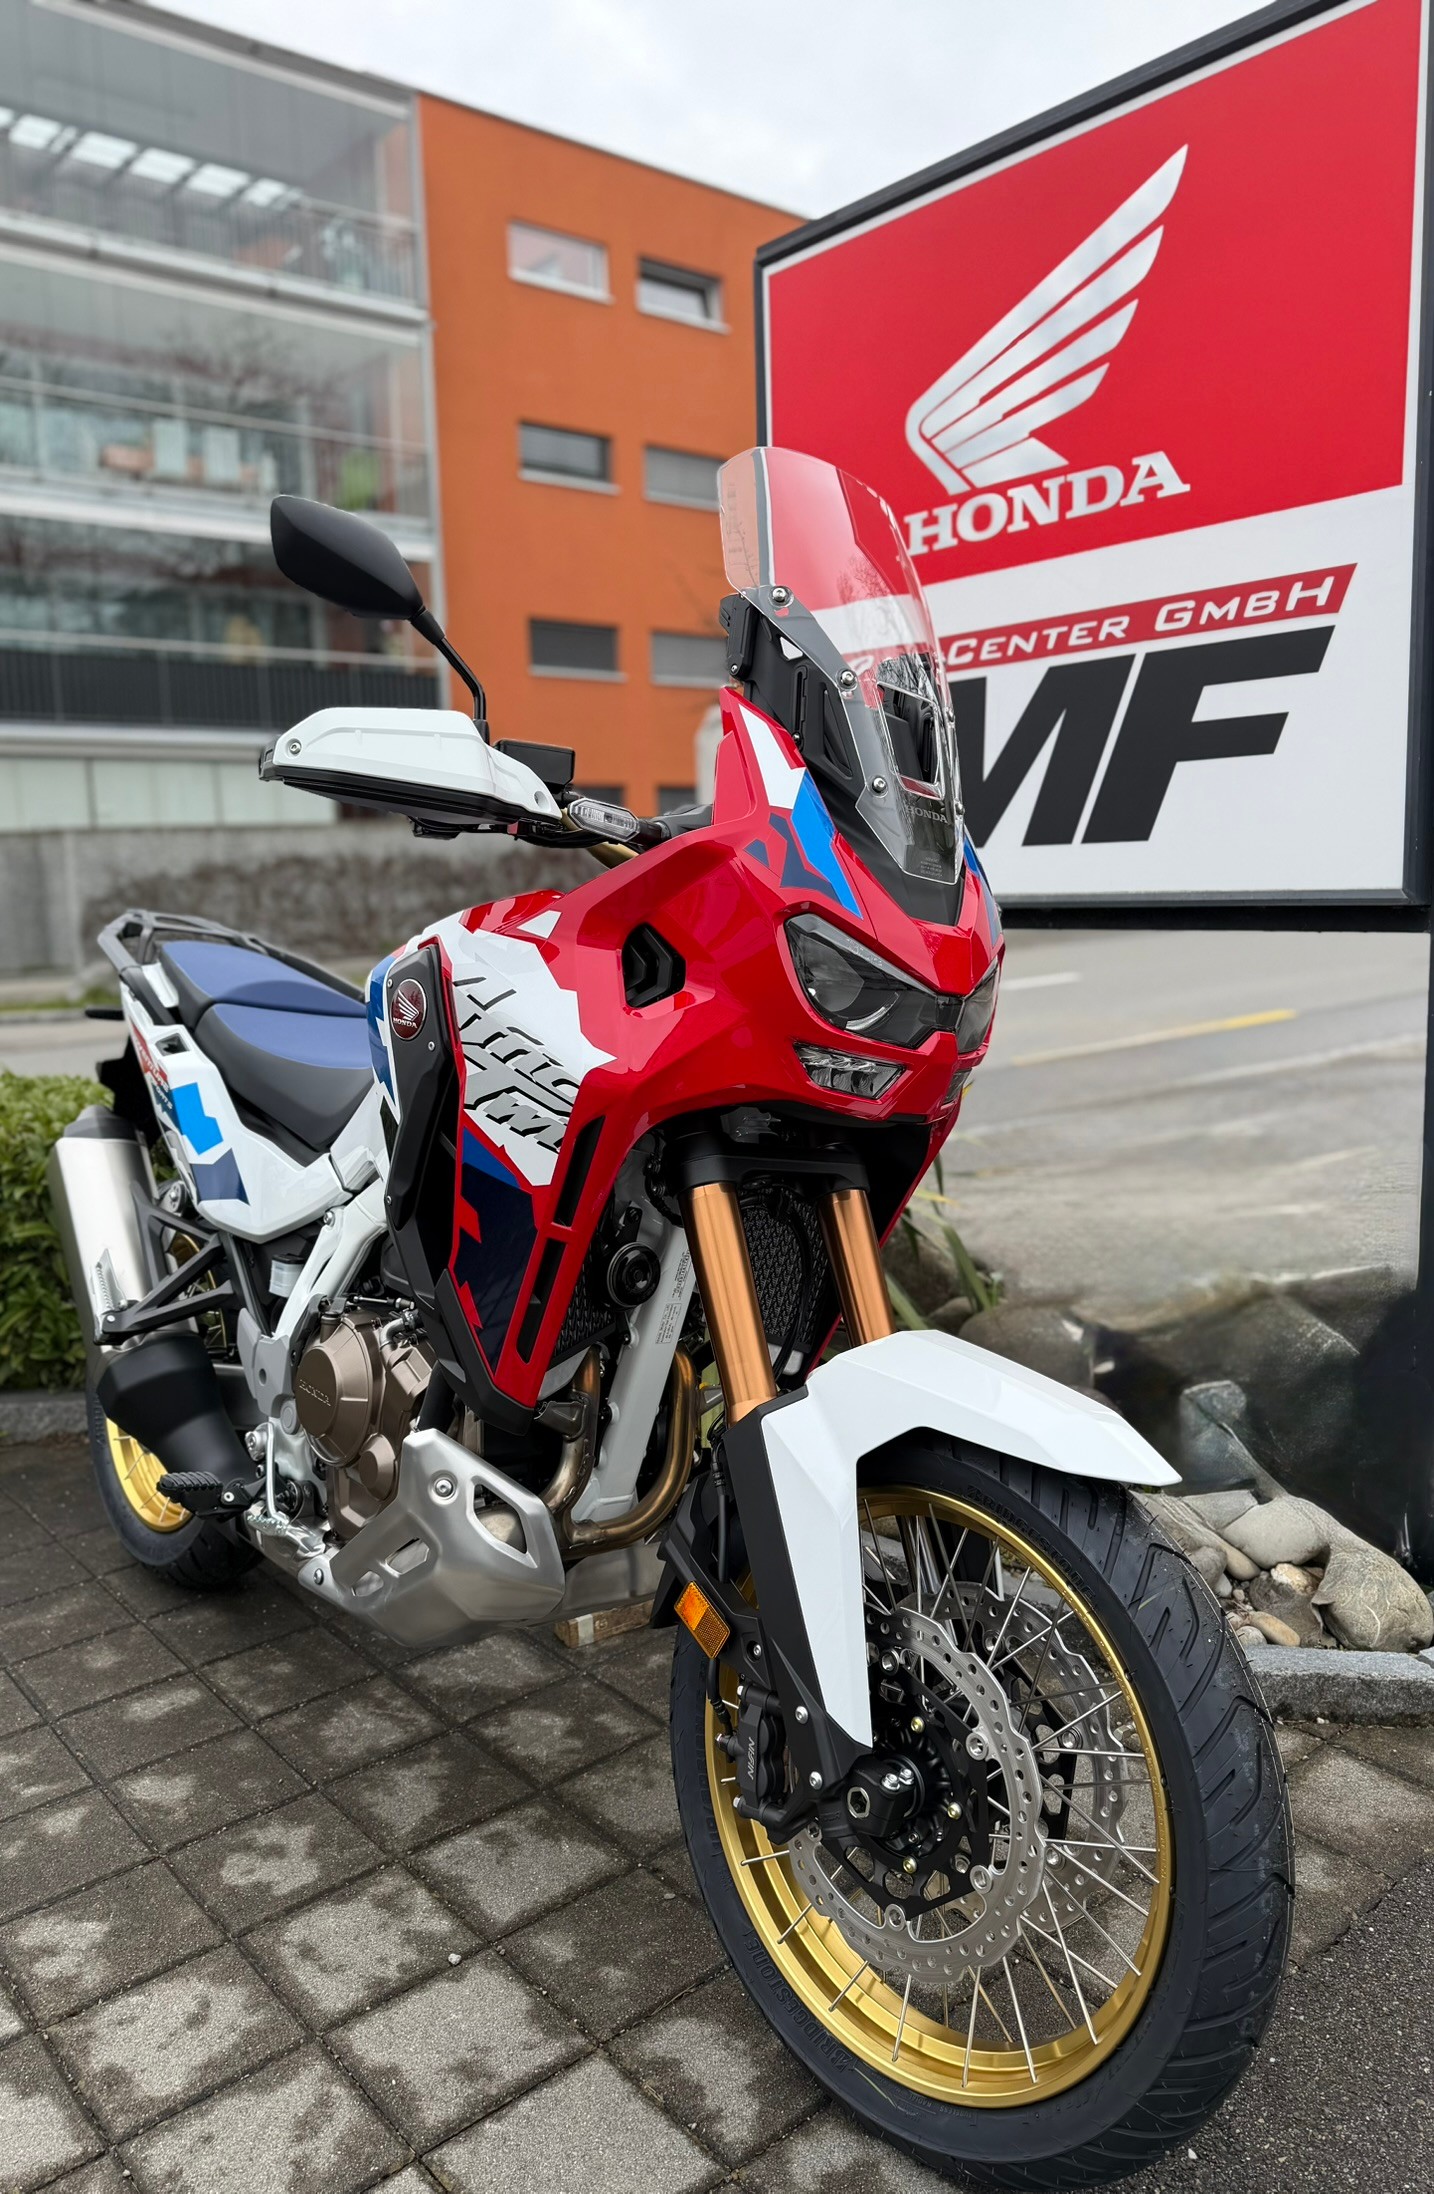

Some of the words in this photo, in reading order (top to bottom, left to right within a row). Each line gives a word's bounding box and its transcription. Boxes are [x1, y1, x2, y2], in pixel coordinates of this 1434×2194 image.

[896, 450, 1191, 562] HONDA
[906, 804, 948, 824] HONDA
[392, 1017, 418, 1029] HONDA
[747, 1736, 756, 1781] NISSIN
[744, 1937, 854, 2075] BRIDGESTONE
